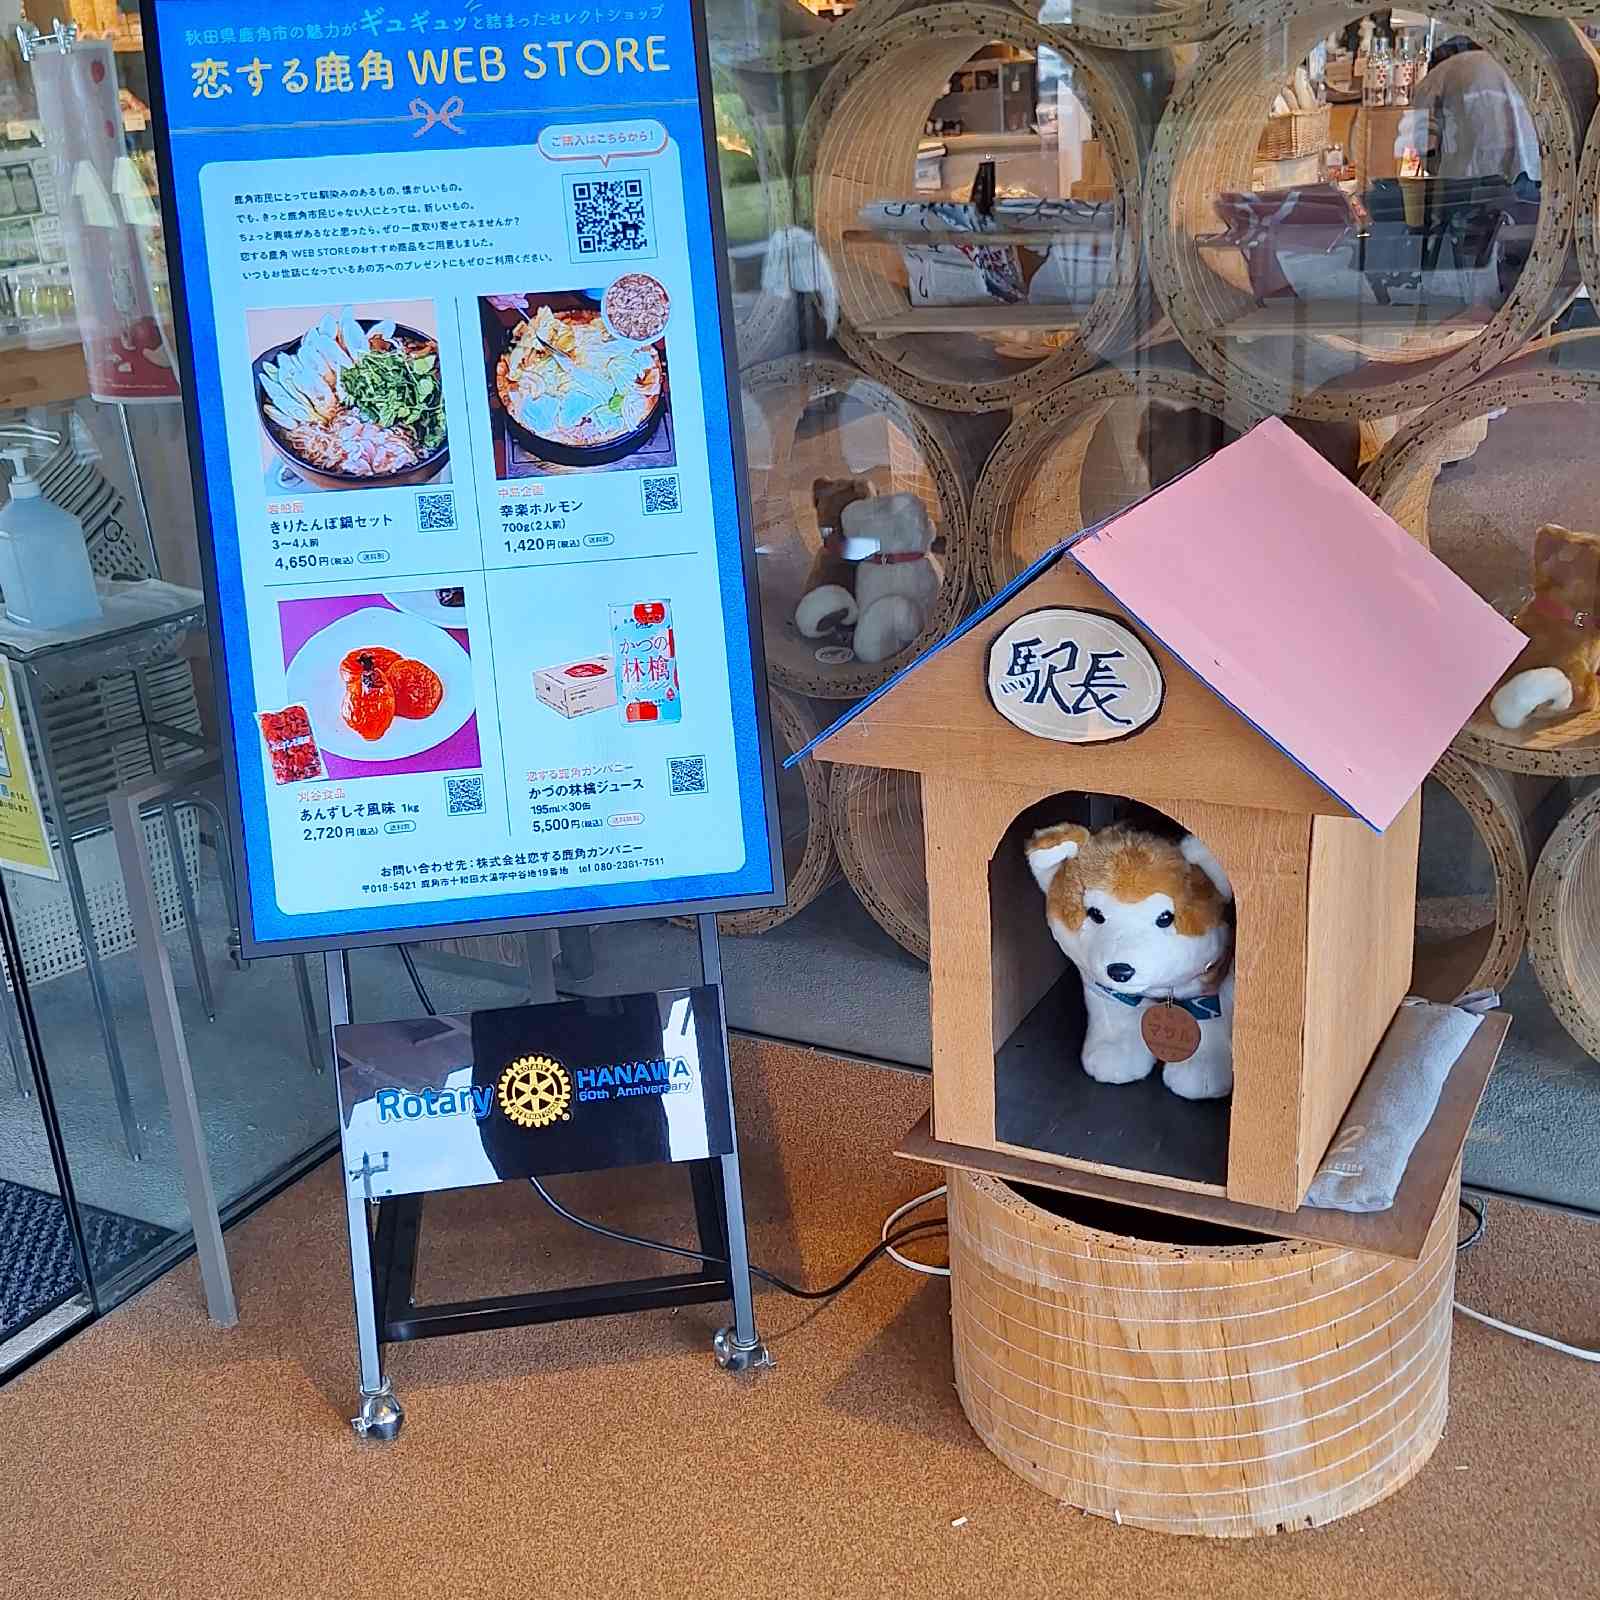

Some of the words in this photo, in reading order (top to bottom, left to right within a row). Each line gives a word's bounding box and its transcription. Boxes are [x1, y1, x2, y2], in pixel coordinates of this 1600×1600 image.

[190, 49, 395, 99] 恋する鹿角
[408, 46, 507, 85] WEB
[523, 35, 671, 80] STORE
[291, 248, 315, 258] WEB
[500, 500, 584, 518] 幸楽ホルモン
[269, 514, 393, 535] きりたんぽ鍋セット
[1000, 636, 1134, 726] 駅長
[528, 778, 645, 800] かづの林檎ジュース
[300, 803, 397, 822] あんずしそ風味
[376, 1085, 494, 1121] Rotary
[576, 1059, 691, 1089] HANAWA
[578, 1089, 610, 1102] 60th
[616, 1081, 691, 1097] Anniversary
